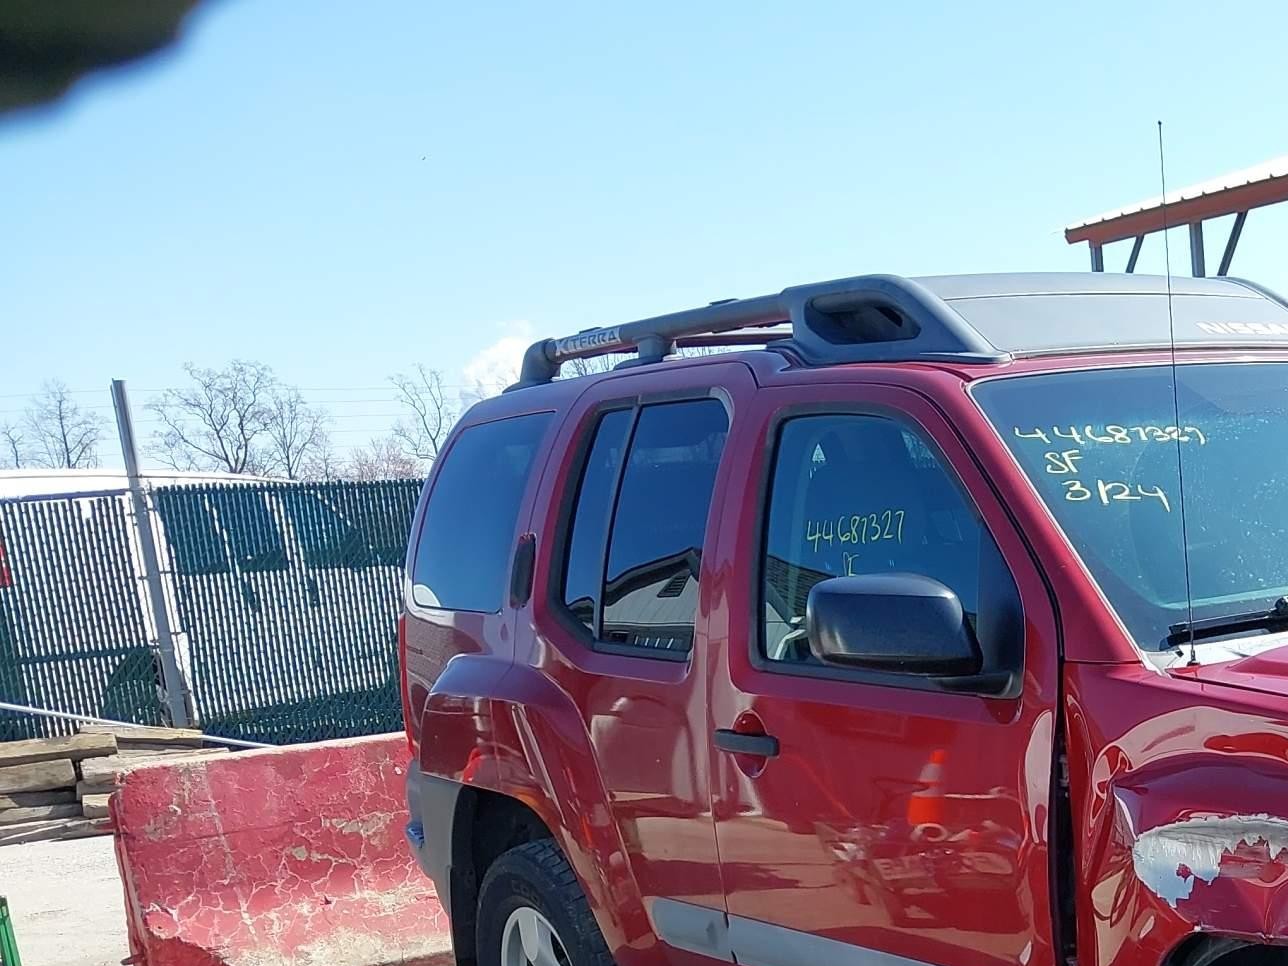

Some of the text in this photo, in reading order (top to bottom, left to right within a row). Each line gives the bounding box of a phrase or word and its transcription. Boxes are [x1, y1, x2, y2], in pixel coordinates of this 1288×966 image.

[1044, 449, 1084, 474] SF
[1061, 479, 1171, 513] 3/24
[806, 509, 905, 553] 44687327
